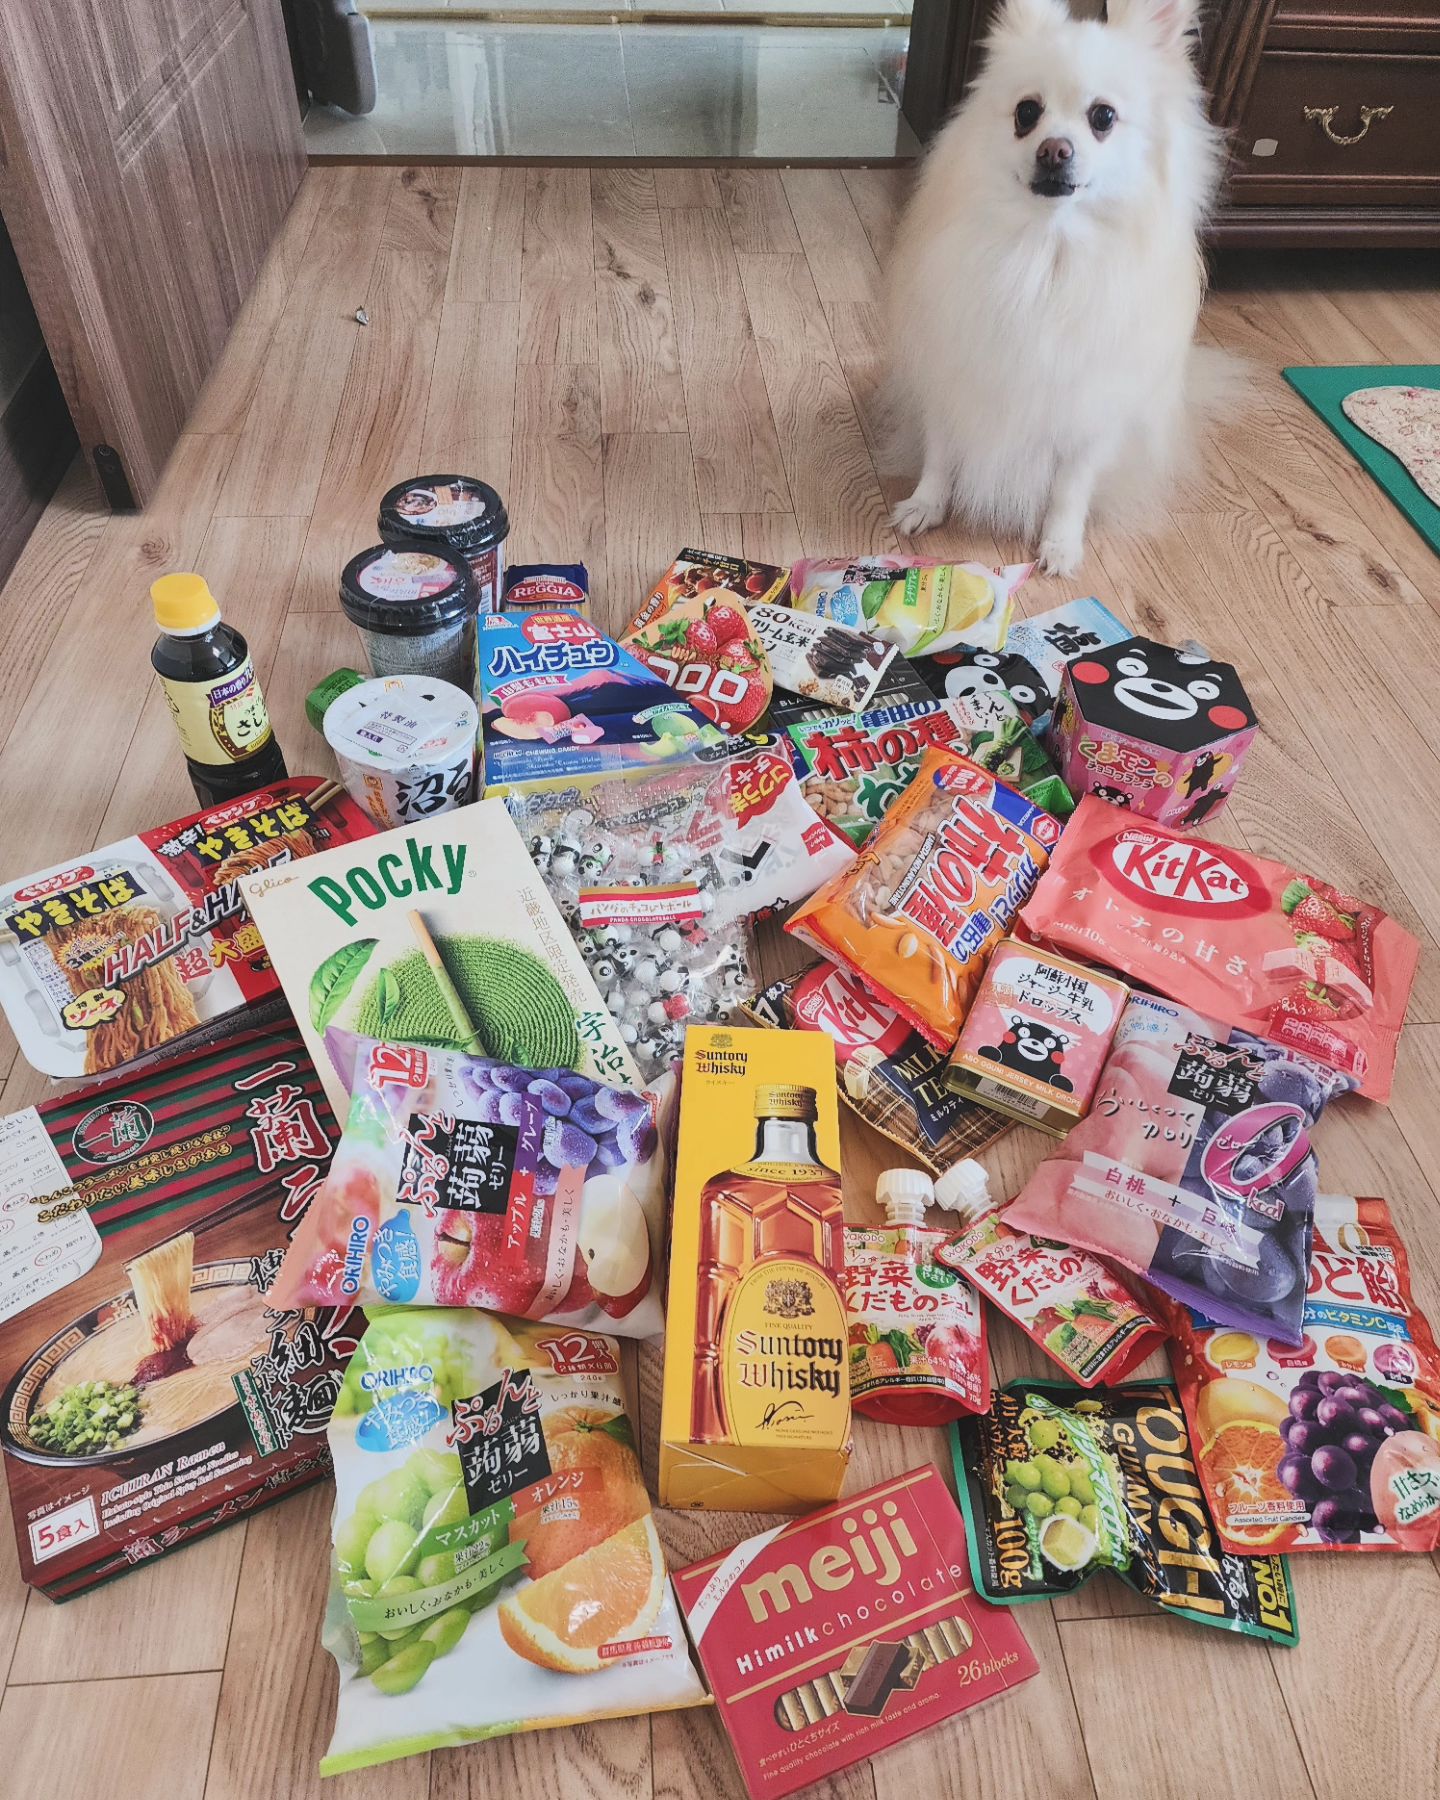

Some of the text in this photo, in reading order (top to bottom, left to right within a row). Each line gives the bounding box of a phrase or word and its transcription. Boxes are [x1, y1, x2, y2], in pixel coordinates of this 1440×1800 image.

[514, 584, 577, 599] REGGIA
[527, 622, 596, 641] 富士山
[488, 638, 618, 677] ハイチュウ
[861, 700, 941, 728] 亀田の
[803, 709, 961, 782] 柿の種
[1078, 741, 1173, 788] くまモンの
[1087, 760, 1154, 789] チョコクランチ
[196, 802, 311, 861] やきそば
[250, 876, 300, 898] Glico
[899, 796, 1027, 951] 柿の種
[1122, 840, 1249, 902] KitKat
[15, 876, 135, 937] やきそば
[951, 910, 995, 961] 亀田の
[1071, 886, 1249, 978] オトナの甘さ
[1018, 973, 1095, 1013] ジャージー牛乳
[1035, 963, 1089, 996] 阿蘇小国
[819, 970, 891, 1044] KitK
[1016, 989, 1083, 1026] ドロップス
[575, 1011, 633, 1080] 宇治
[694, 1049, 748, 1063] Suntory
[1173, 1034, 1270, 1081] ぷるんと
[696, 1061, 746, 1077] Whisky
[1003, 1066, 1035, 1087] JERSEY
[1034, 1078, 1054, 1095] MILK
[1055, 1086, 1082, 1108] DROPS
[1175, 1060, 1254, 1104] 蒟蒻
[1189, 1088, 1231, 1108] ゼリー
[397, 1109, 458, 1220] ぷるんと
[446, 1123, 496, 1210] 蒟蒻
[489, 1146, 505, 1192] ゼリー
[506, 1099, 540, 1250] アップル グレープ
[792, 1165, 824, 1177] 1937
[1105, 1166, 1146, 1196] 白桃
[340, 1215, 371, 1296] ORIHIRO
[845, 1260, 913, 1289] 野菜
[975, 1246, 1049, 1293] 野菜
[846, 1290, 939, 1313] くだもの
[1011, 1257, 1083, 1307] くだもの
[736, 1330, 843, 1367] Suntory
[765, 1322, 814, 1332] FINE QUALITY
[739, 1361, 842, 1399] Whisky
[446, 1368, 544, 1448] ぷるんと
[101, 1464, 173, 1506] ICHIRAN
[176, 1442, 226, 1472] Ramen
[462, 1415, 543, 1490] 蒟蒻
[487, 1467, 530, 1493] ゼリー
[1112, 1422, 1152, 1536] GUMMY
[1121, 1384, 1225, 1616] TOUGH
[436, 1471, 584, 1547] マスカット オレンジ
[1228, 1500, 1307, 1515] フルーツ香料使用
[1234, 1514, 1307, 1524] Assorted Fruit Candies
[37, 1518, 91, 1551] 5食入
[994, 1516, 1031, 1590] 100g
[712, 1557, 747, 1602] ミルクのコク
[741, 1500, 918, 1625] meiji
[384, 1556, 505, 1620] おいしく・おなかも・美しく
[697, 1575, 722, 1610] たっぷり
[822, 1564, 963, 1636] chocolate
[957, 1650, 1020, 1687] 26 blocks
[758, 1721, 843, 1769] 食べやすいひとくちサイズ
[763, 1692, 942, 1781] Fine quality chocolate with rich milk taste and aroma.
